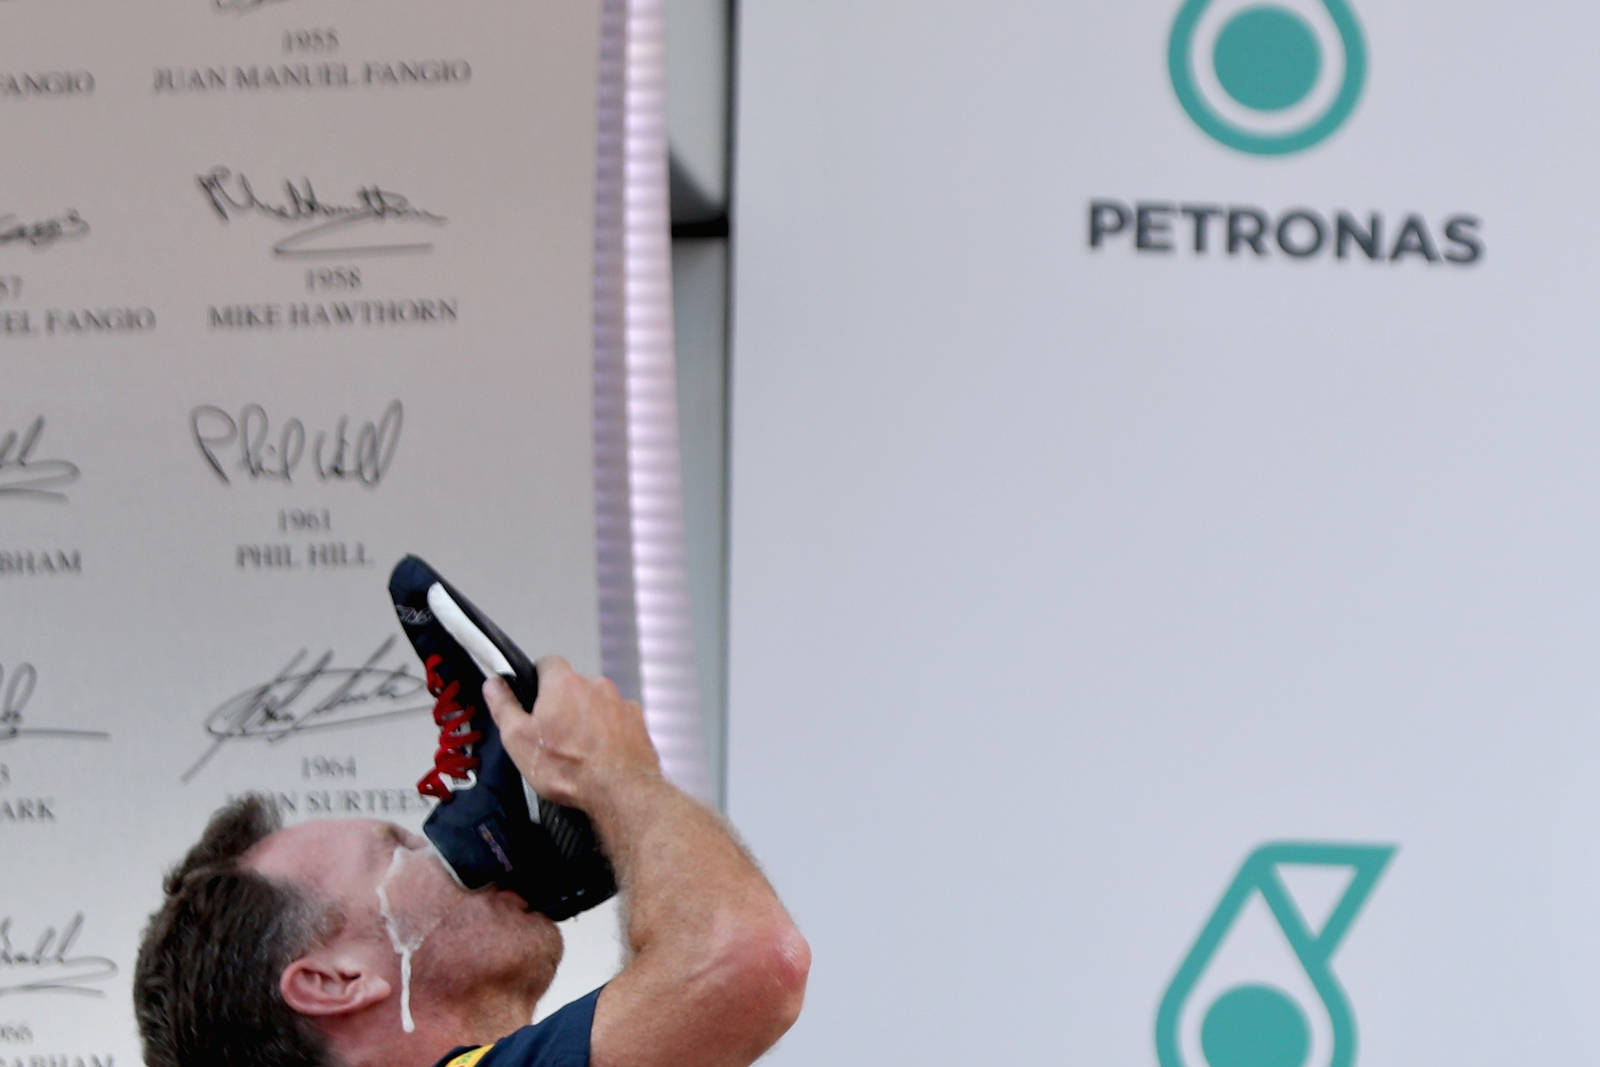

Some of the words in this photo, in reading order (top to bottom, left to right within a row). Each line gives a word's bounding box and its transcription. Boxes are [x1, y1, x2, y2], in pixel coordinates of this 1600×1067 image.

[152, 67, 227, 94] JUAN
[236, 64, 354, 90] MANUEL
[363, 59, 473, 87] FANGIO
[1087, 199, 1485, 266] PETRONAS
[306, 266, 361, 291] 1958
[46, 304, 156, 332] FANGIO
[209, 302, 282, 330] MIKE
[291, 298, 458, 327] HAWTHORN
[279, 508, 332, 532] 1961
[236, 544, 298, 570] PHIL
[307, 541, 372, 567] HILL
[302, 756, 357, 780] 1964
